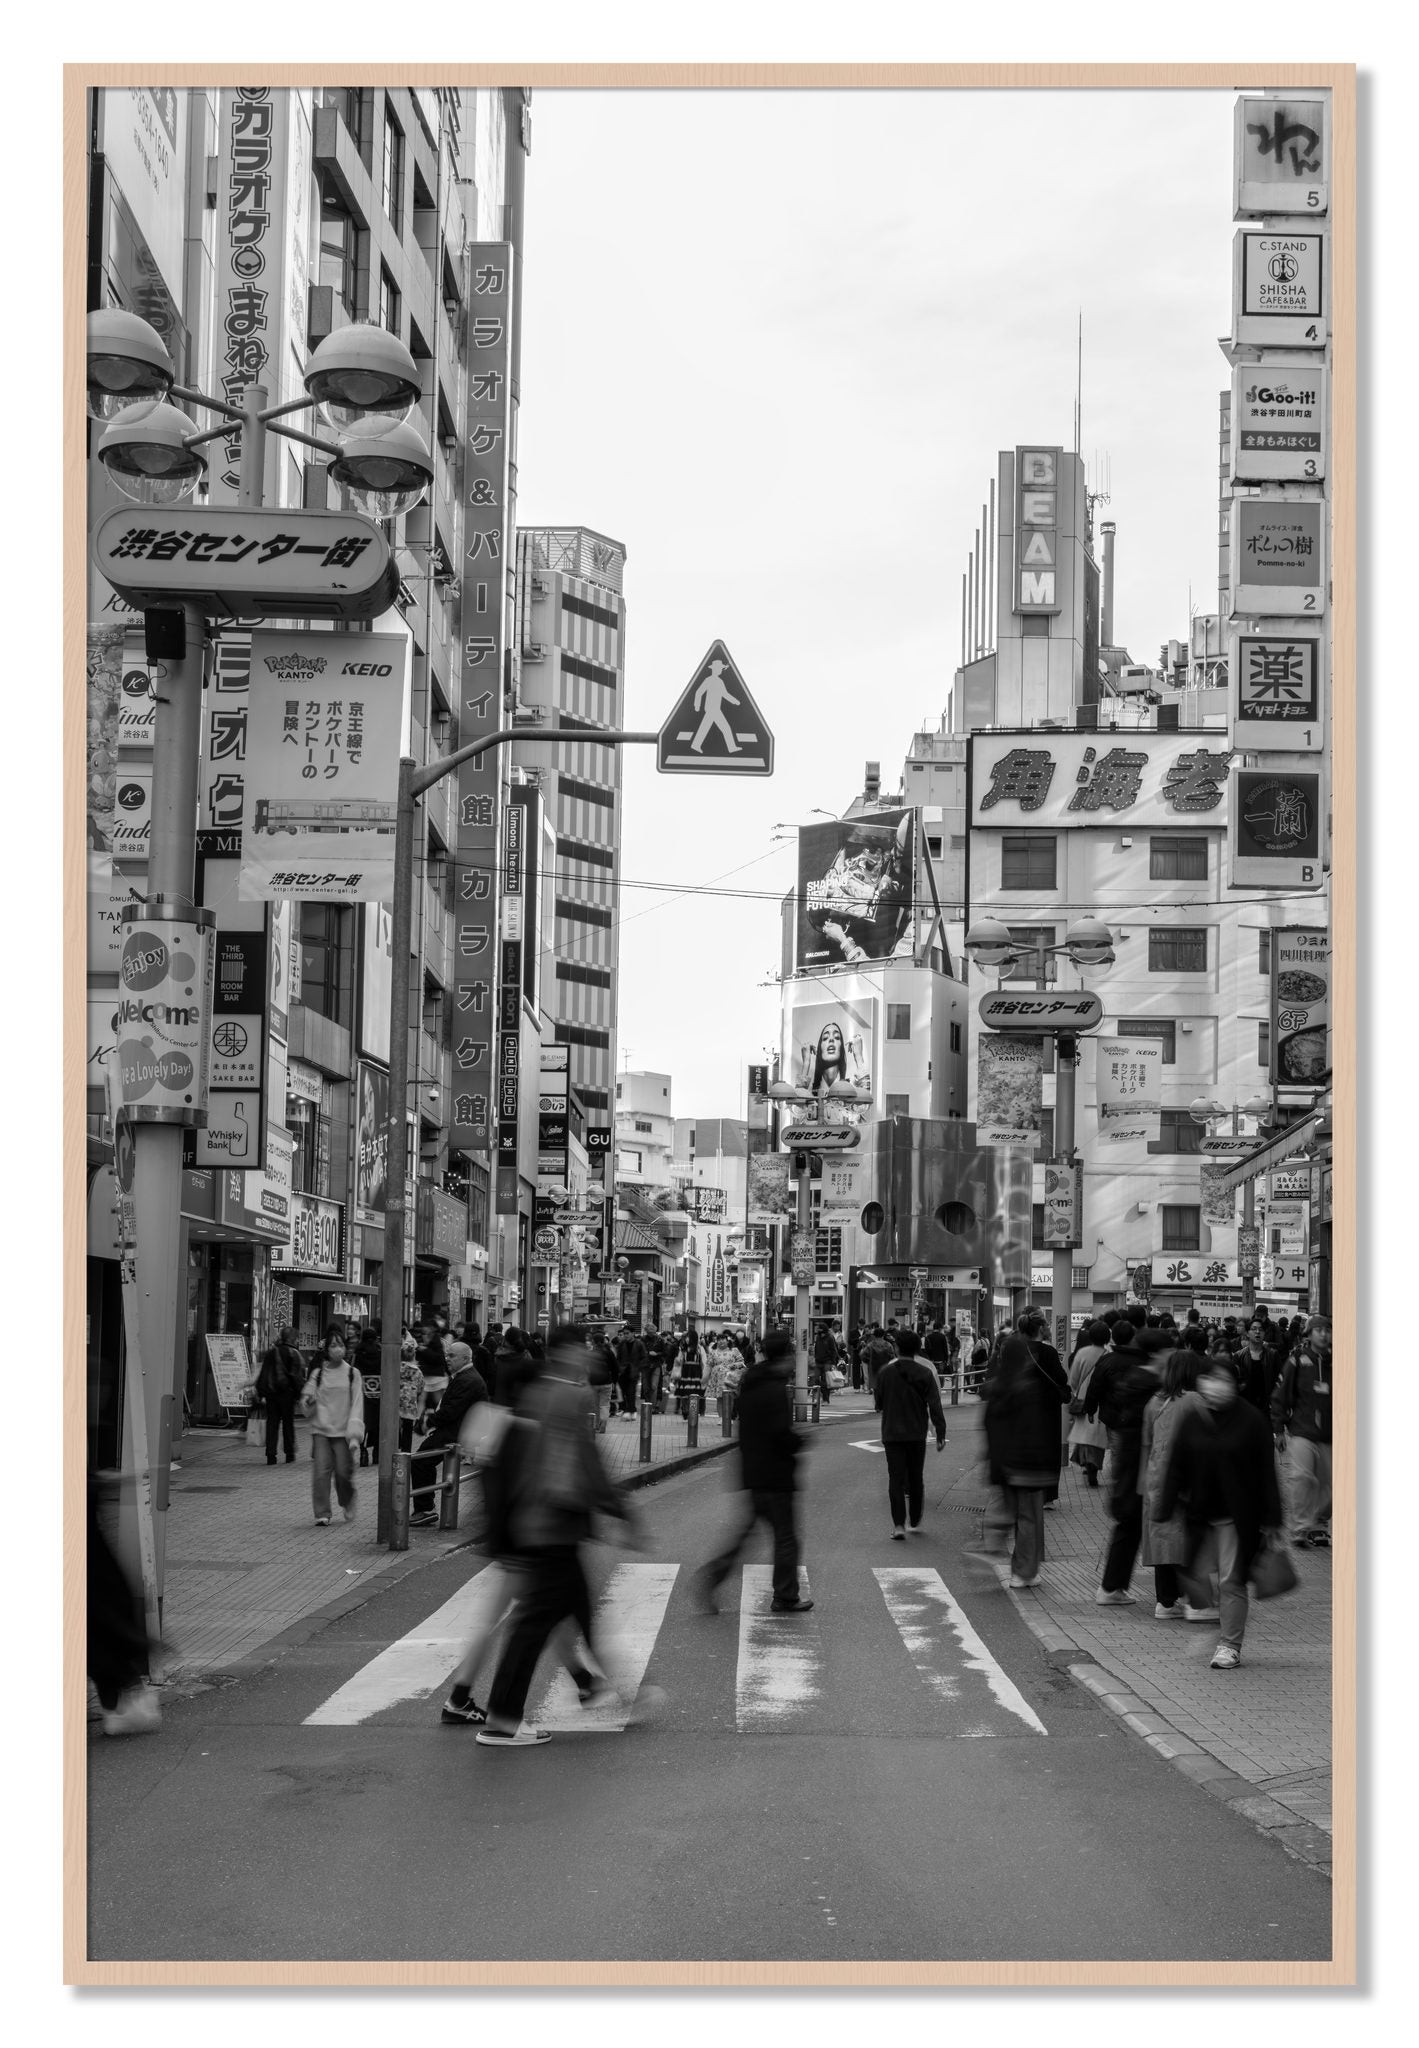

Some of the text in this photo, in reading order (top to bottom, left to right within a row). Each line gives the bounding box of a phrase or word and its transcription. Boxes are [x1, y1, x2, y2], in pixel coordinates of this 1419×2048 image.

[230, 101, 271, 247] カラオケ
[1306, 191, 1320, 207] 5
[1259, 241, 1308, 253] C.STAND
[1259, 284, 1307, 296] SHISHA
[1259, 296, 1307, 305] CAFE&BAR
[1305, 325, 1318, 341] 4
[1258, 387, 1316, 405] Goo-it!
[1250, 408, 1312, 418] 渋谷宇田川町店
[1245, 435, 1317, 448] 全身もみほぐし
[1304, 459, 1317, 476] 3
[1023, 452, 1056, 605] BEAM
[109, 528, 373, 567] 渋谷センター街
[1303, 593, 1316, 611] 2
[277, 671, 315, 679] KANTO
[341, 662, 393, 677] KEIO
[1249, 645, 1304, 699] 薬
[282, 700, 300, 746] 冒険へ
[123, 729, 149, 739] 渋谷店
[302, 701, 321, 780] カントーの
[323, 701, 343, 780] ポケパーク
[346, 702, 365, 765] 京王線で
[1303, 730, 1312, 746] 1
[979, 747, 1231, 812] 角海老
[1243, 789, 1308, 840] 一蘭
[118, 843, 145, 853] 渋谷店
[508, 810, 518, 889] kimono hearts
[269, 872, 363, 887] 渋谷センター街
[1302, 865, 1314, 882] B
[806, 878, 847, 891] SHAPING
[221, 952, 245, 960] THIRD
[225, 945, 241, 953] THE
[1279, 949, 1327, 963] 四川料理
[122, 946, 167, 984] Enjoy
[220, 982, 244, 991] ROOM
[453, 869, 492, 1128] カラオケ館
[119, 998, 200, 1026] Welcome
[986, 1001, 1096, 1016] 渋谷センター街
[1278, 1010, 1309, 1031] 6F
[137, 1061, 169, 1082] Lovely
[170, 1062, 192, 1076] Day!
[207, 1130, 243, 1142] Whisky
[589, 1133, 611, 1146] GU
[785, 1131, 851, 1140] 渋谷センター街
[207, 1139, 229, 1150] Bank
[704, 1233, 712, 1313] SHIBUYA
[1166, 1260, 1230, 1283] 兆楽
[715, 1258, 723, 1304] BEER
